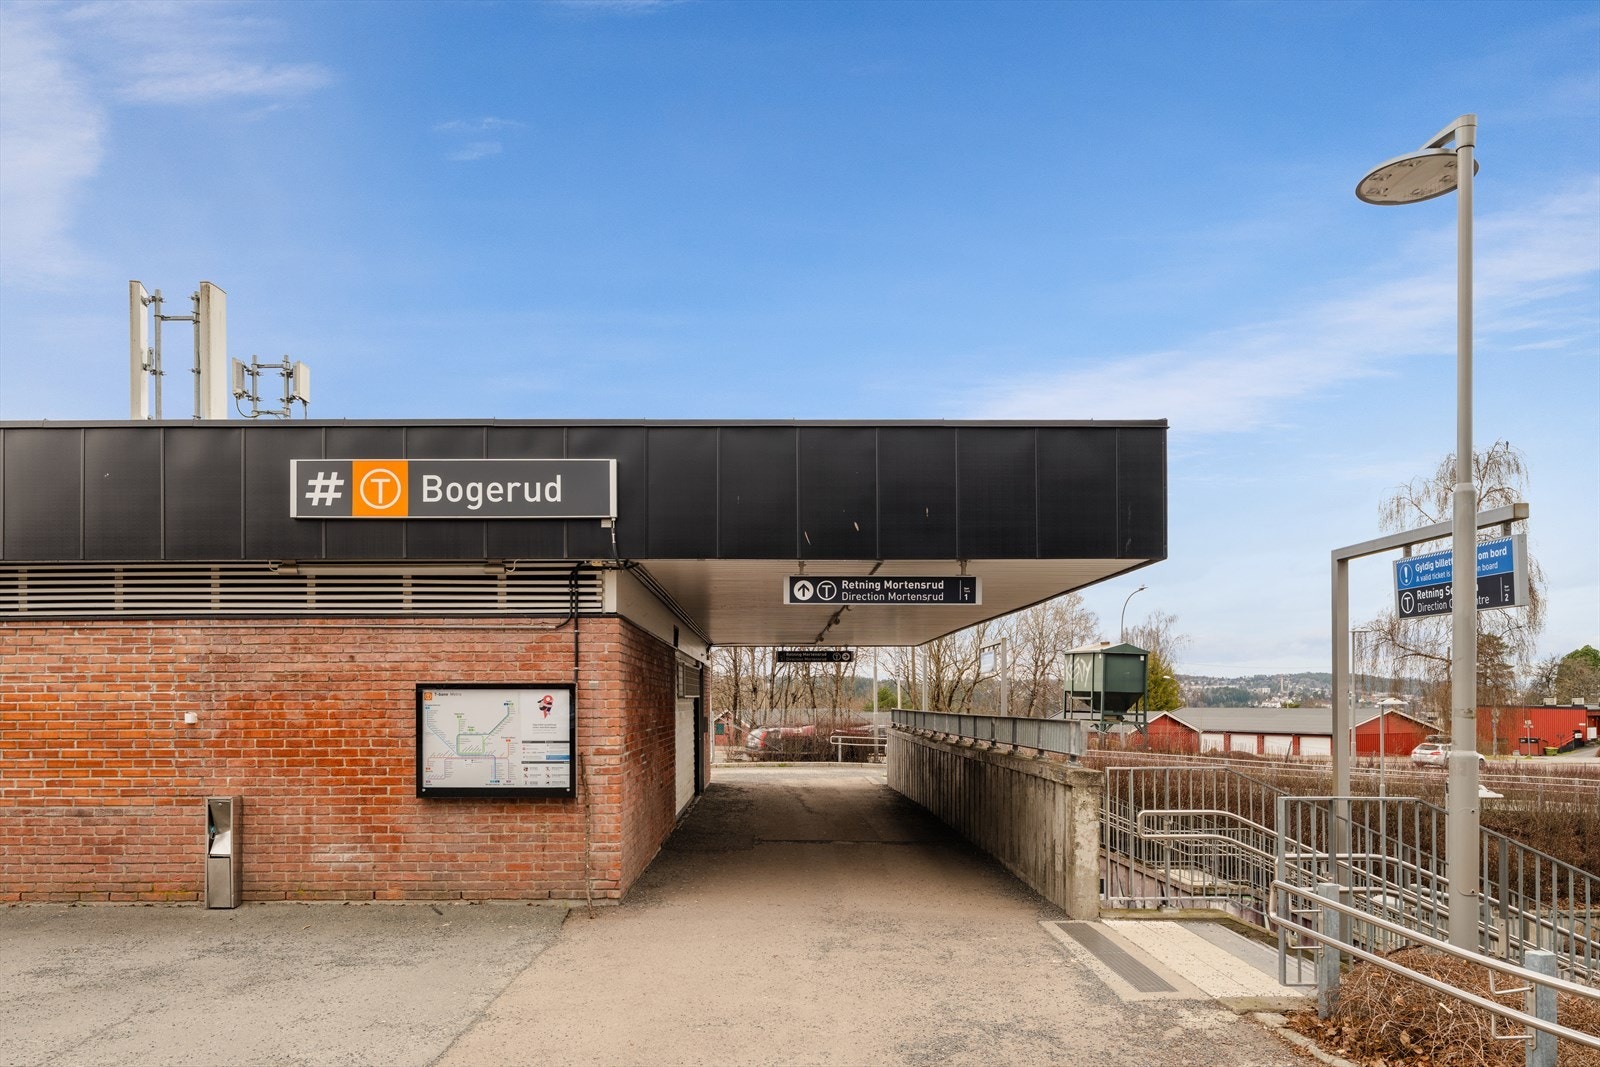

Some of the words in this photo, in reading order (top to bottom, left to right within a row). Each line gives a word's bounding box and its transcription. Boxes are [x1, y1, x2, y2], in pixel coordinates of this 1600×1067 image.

[422, 474, 562, 510] Bogerud
[1415, 562, 1434, 573] Gyldig
[1478, 551, 1489, 559] om
[1490, 546, 1507, 557] bord
[1433, 571, 1446, 580] ticket
[1482, 562, 1498, 571] board
[841, 580, 881, 591] Retning
[884, 580, 944, 589] Mortensrud
[841, 592, 885, 601] Direction
[888, 592, 944, 601] Mortensrud
[964, 593, 968, 601] 1
[1416, 588, 1444, 600] Retning
[1504, 593, 1509, 602] 2
[1417, 601, 1448, 613] Direction
